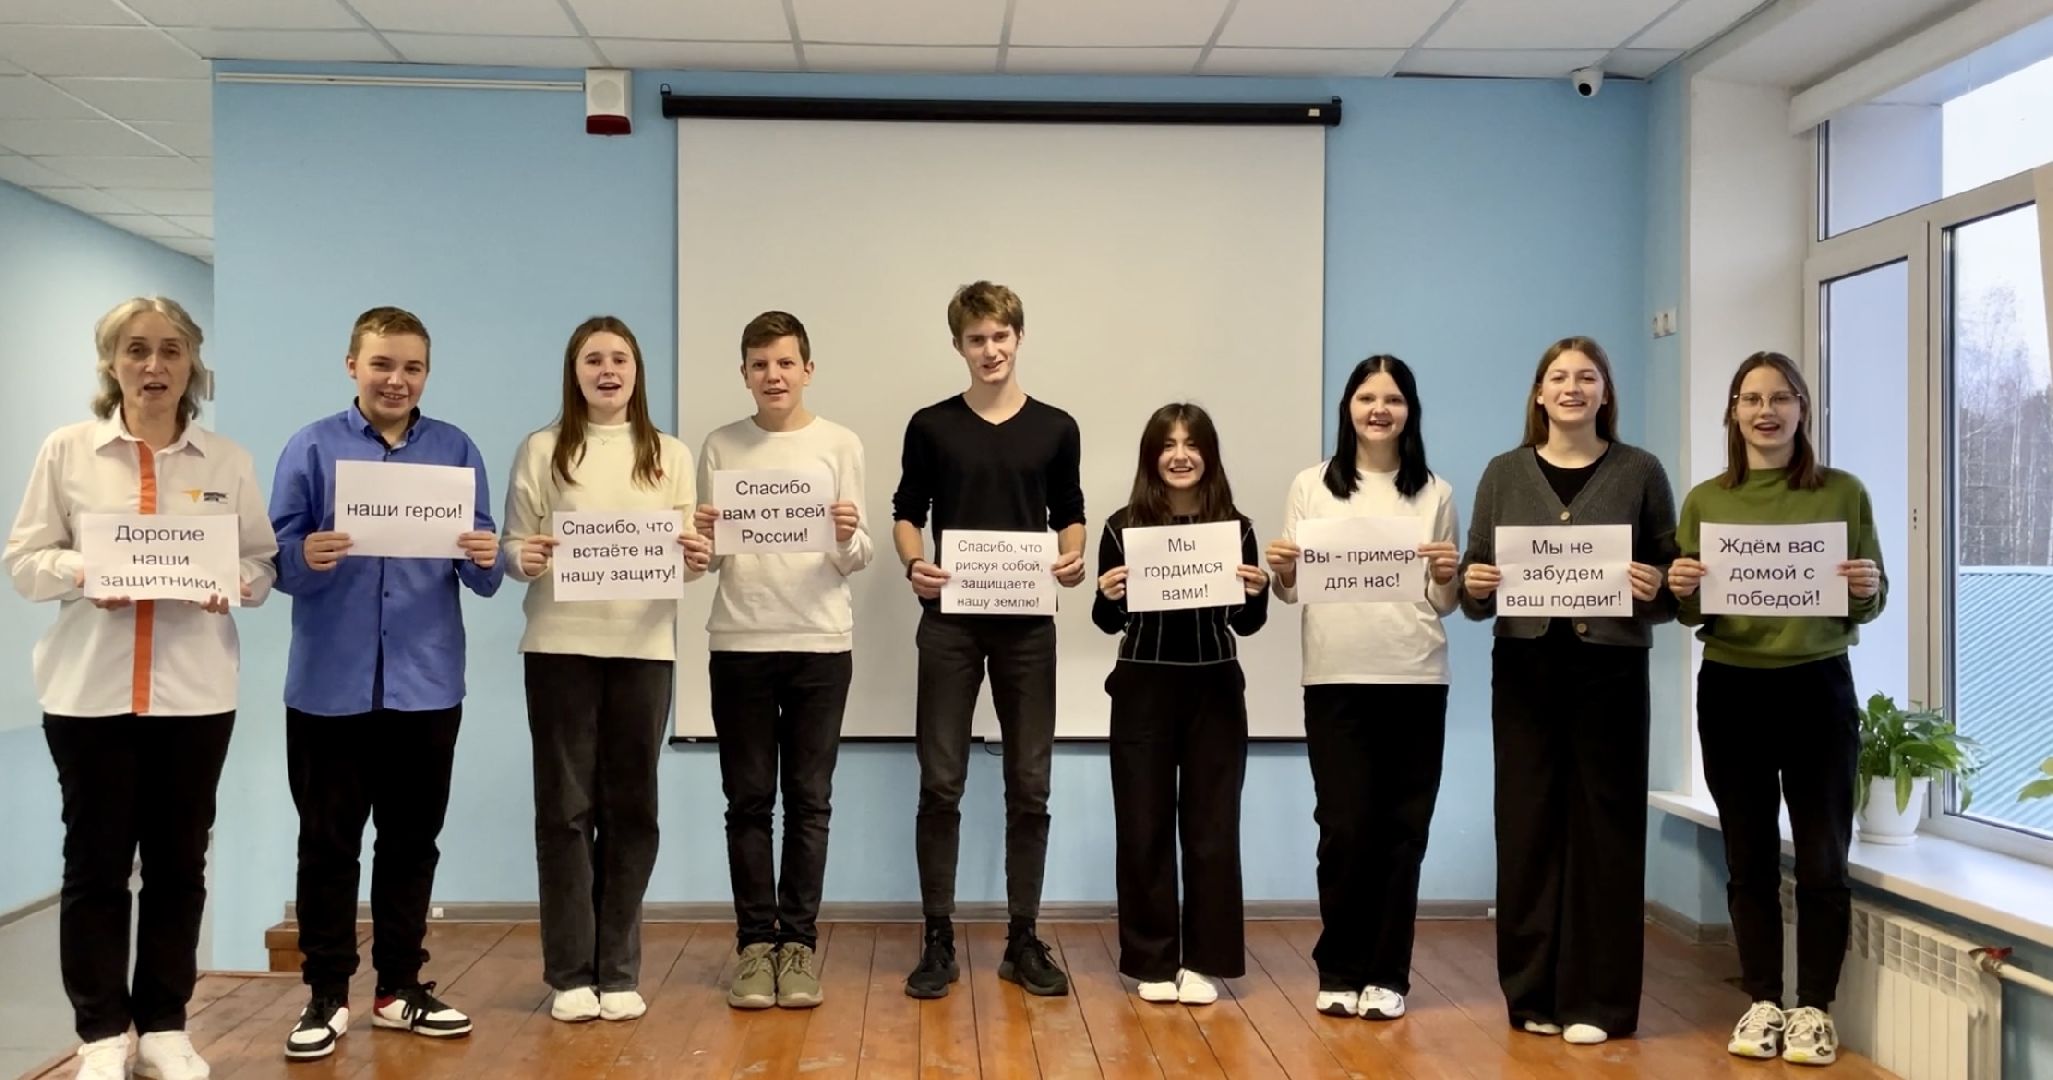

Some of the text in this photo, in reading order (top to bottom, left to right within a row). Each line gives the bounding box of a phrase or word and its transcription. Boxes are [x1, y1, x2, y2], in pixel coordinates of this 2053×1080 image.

[736, 479, 811, 496] Спасибо
[347, 503, 463, 523] наши герои!
[723, 503, 826, 520] вам от всей
[114, 524, 205, 545] Дорогие
[561, 519, 674, 537] Спасибо, что
[741, 528, 808, 545] России!
[572, 541, 664, 559] встаёте на
[957, 539, 1043, 556] Спасибо, что
[1167, 537, 1197, 553] Мы
[1531, 539, 1594, 555] Мы не
[1719, 537, 1825, 556] Ждём вас
[132, 553, 190, 566] наши
[955, 557, 1044, 575] рискуя собой,
[1303, 548, 1330, 565] Вы
[1347, 548, 1416, 566] пример
[560, 565, 676, 586] нашу защиту!
[1143, 559, 1223, 578] гордимся
[1522, 566, 1604, 584] забудем
[1729, 563, 1815, 583] домой с
[960, 577, 1036, 592] защищаете
[1324, 572, 1400, 591] для нас!
[956, 595, 1040, 610] нашу землю!
[1161, 585, 1209, 602] вами!
[1505, 590, 1622, 610] ваш подвиг!
[1726, 589, 1820, 610] победой!
